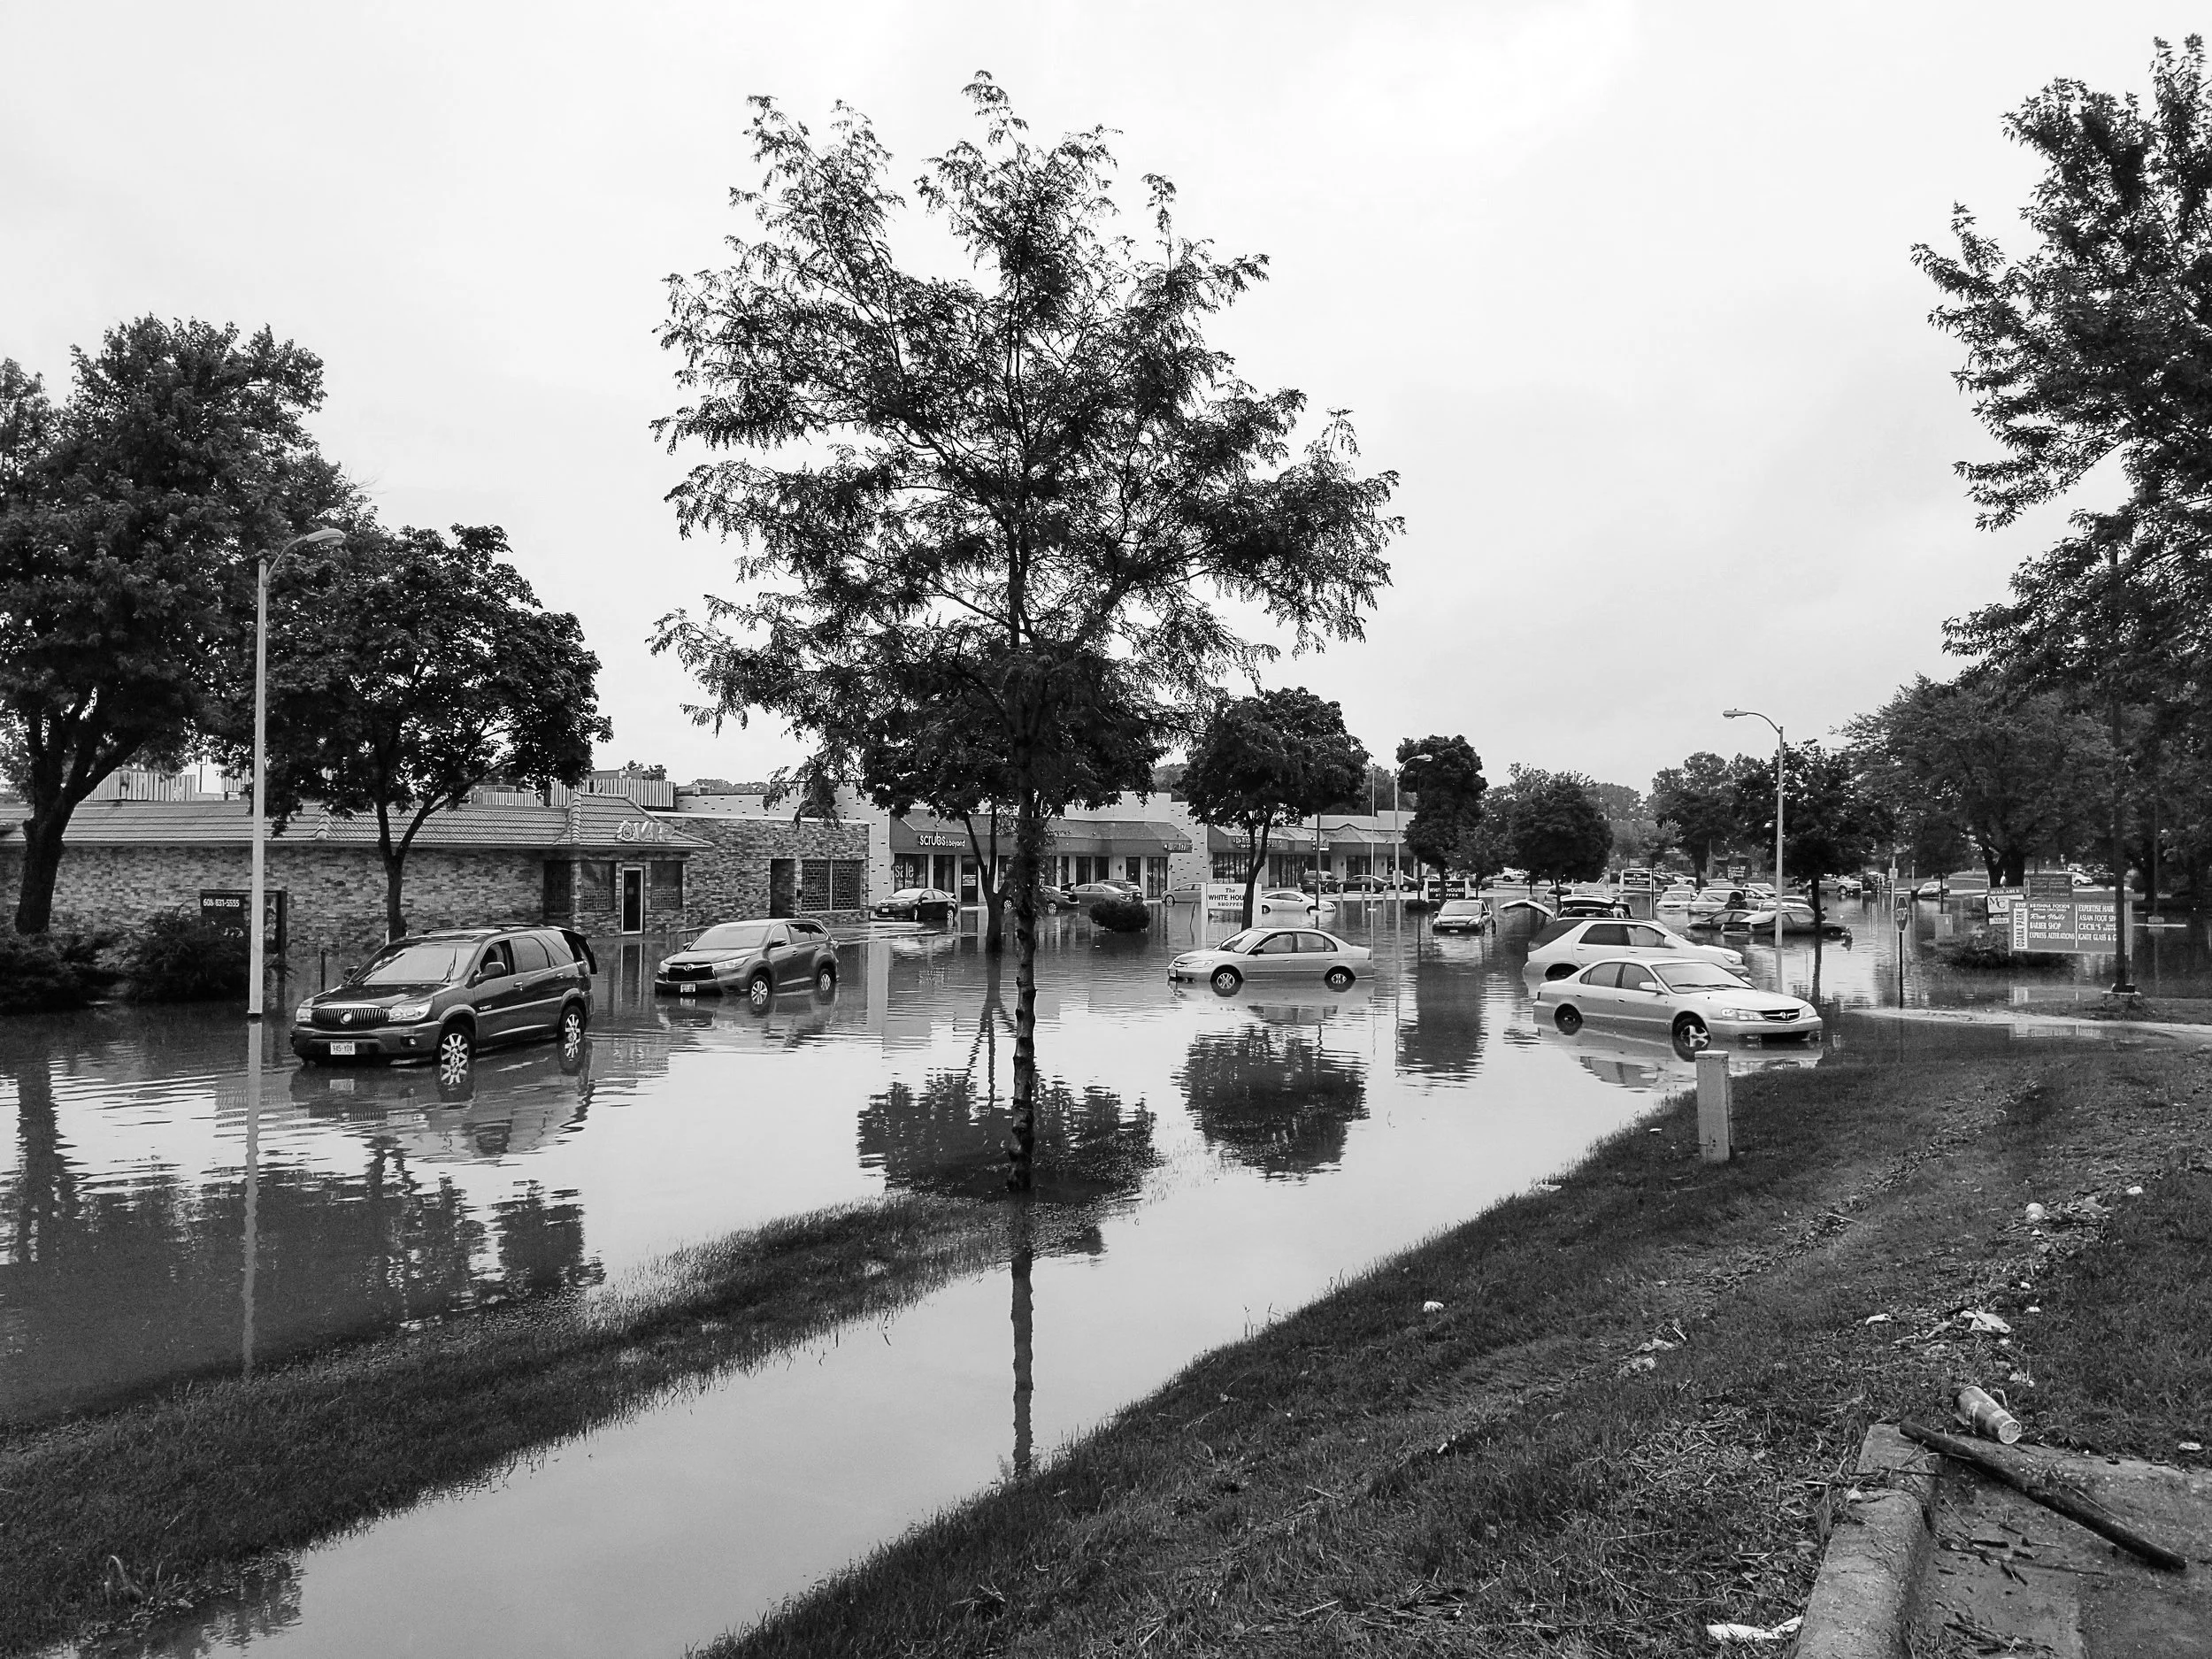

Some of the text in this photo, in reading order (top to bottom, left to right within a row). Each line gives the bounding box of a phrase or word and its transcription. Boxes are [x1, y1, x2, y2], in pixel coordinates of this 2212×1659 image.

[920, 832, 946, 846] scrubs
[203, 898, 214, 907] 608
[2016, 910, 2025, 926] PARK
